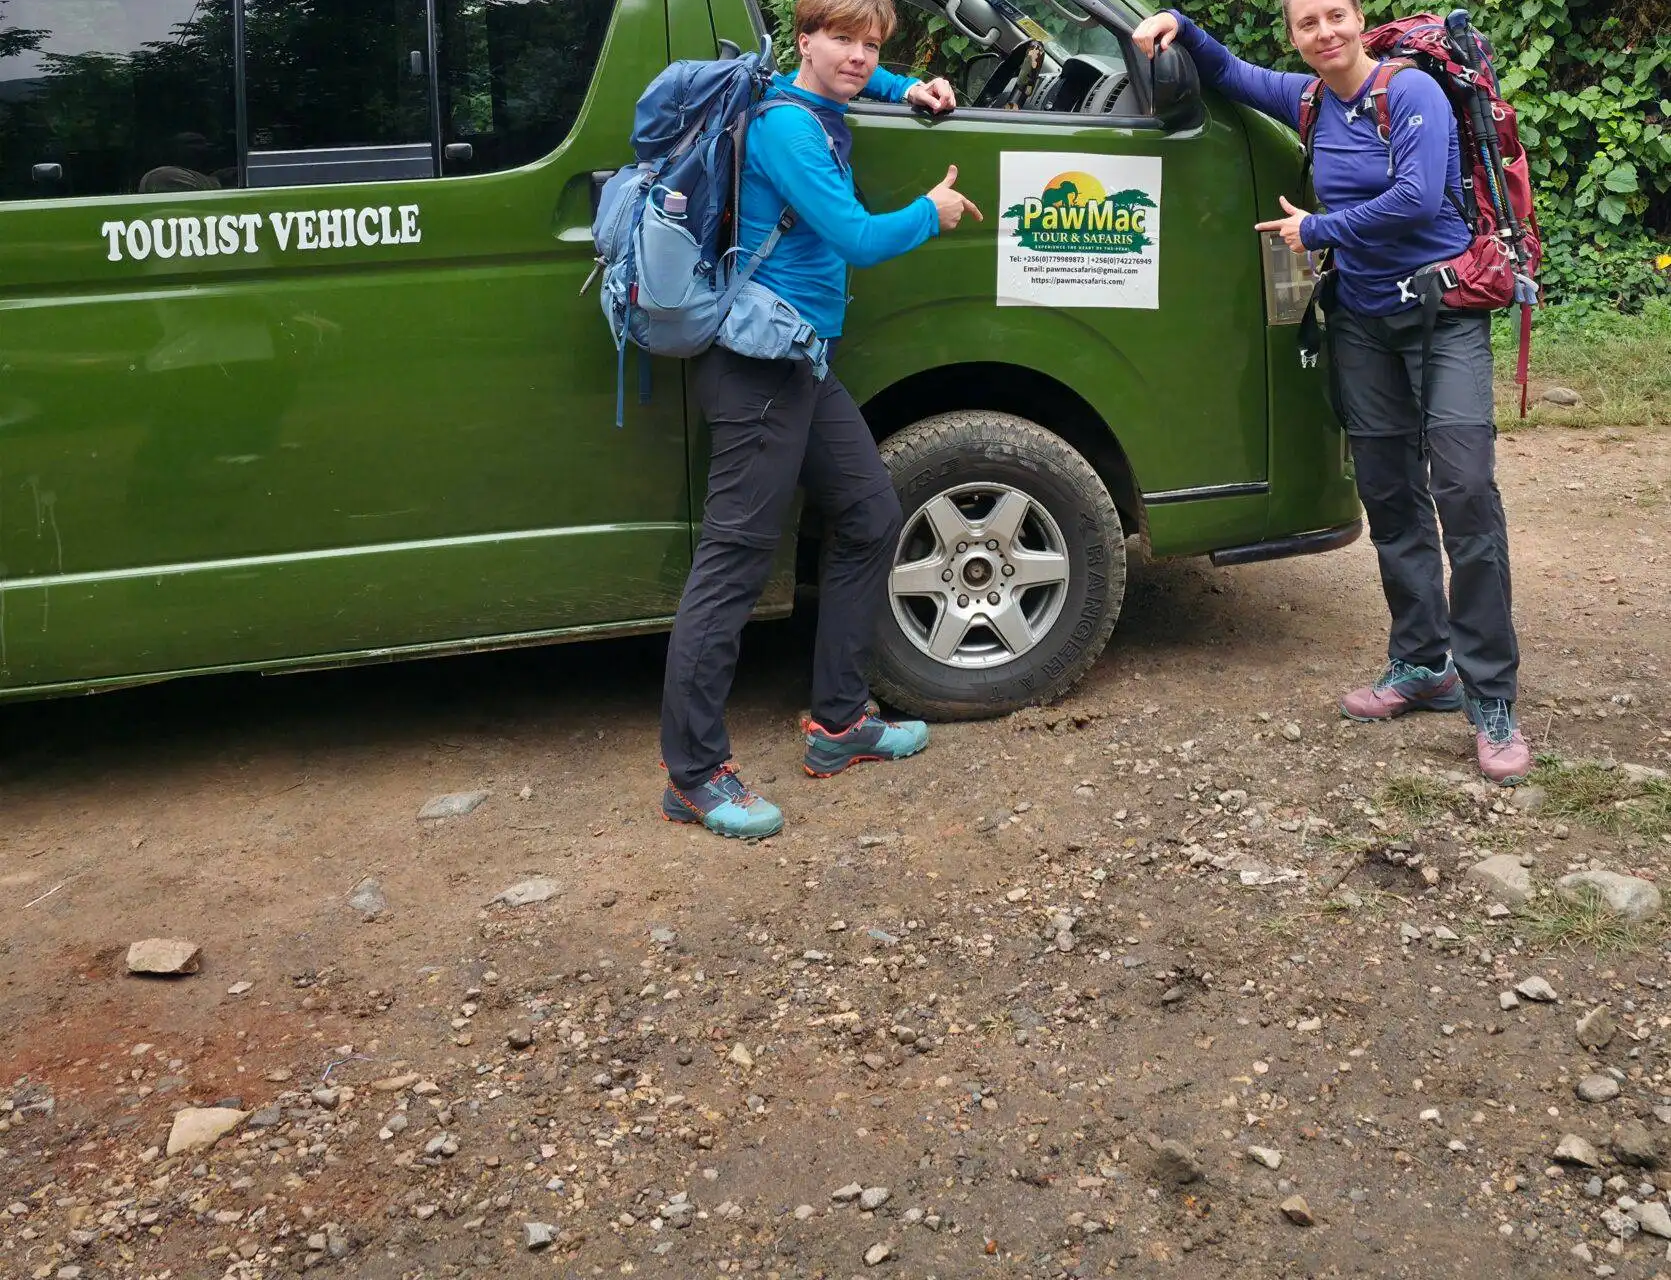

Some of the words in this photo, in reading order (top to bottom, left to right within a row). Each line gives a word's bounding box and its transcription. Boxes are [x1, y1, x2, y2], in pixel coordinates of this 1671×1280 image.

[1023, 196, 1146, 234] PawMac
[102, 213, 262, 262] TOURIST
[269, 204, 422, 252] VEHICLE
[1032, 231, 1068, 242] TOUR
[1071, 232, 1081, 243] &
[1083, 232, 1133, 245] SAFARIS
[1023, 265, 1045, 273] Email:
[1045, 266, 1139, 275] pawmacsafaris@gmail.com
